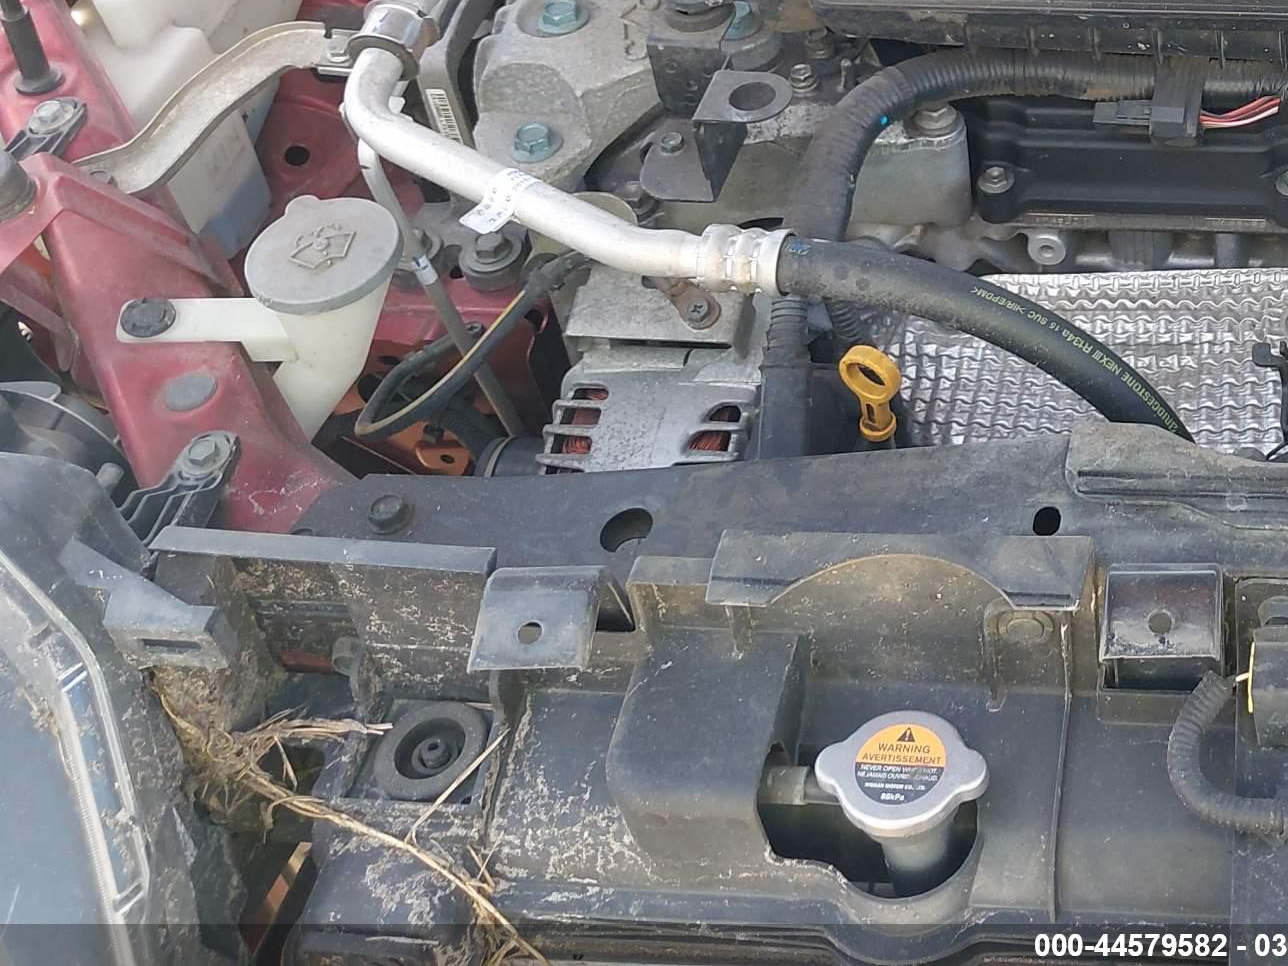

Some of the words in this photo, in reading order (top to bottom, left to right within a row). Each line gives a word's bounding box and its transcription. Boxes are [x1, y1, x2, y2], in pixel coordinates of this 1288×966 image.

[1027, 311, 1049, 326] SUC
[1063, 330, 1094, 353] R134a
[877, 742, 931, 754] WARNING
[862, 753, 942, 764] AVERTISSEMENT
[860, 764, 882, 772] NEVER
